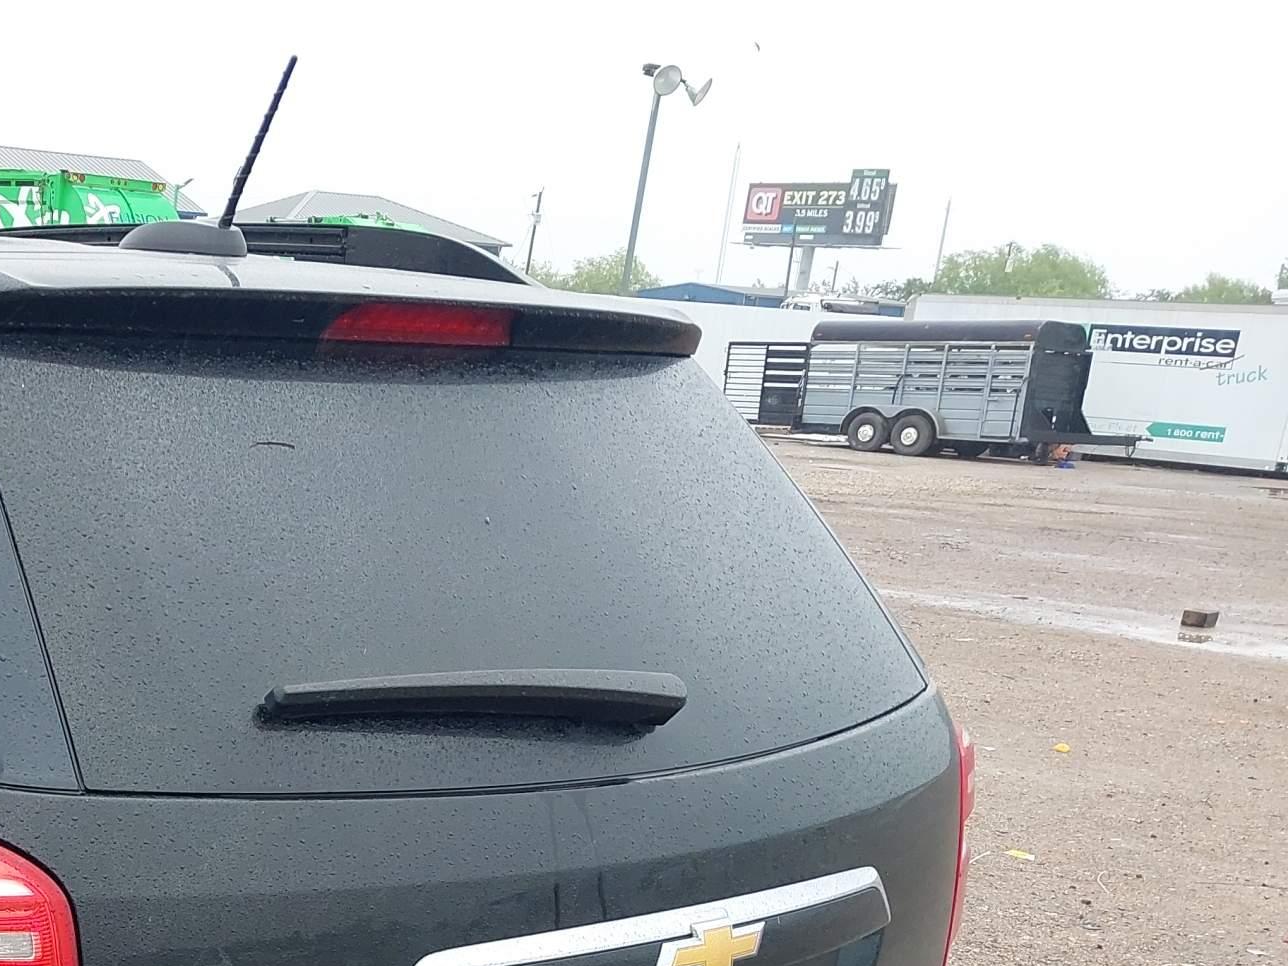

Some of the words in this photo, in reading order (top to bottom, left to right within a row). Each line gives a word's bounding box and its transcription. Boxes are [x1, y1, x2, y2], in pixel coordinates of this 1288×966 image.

[752, 192, 776, 216] QT
[783, 191, 816, 205] EXIT
[817, 191, 846, 205] 273
[807, 209, 828, 217] MILES
[1089, 328, 1236, 354] Enterprise
[1216, 364, 1268, 386] truck
